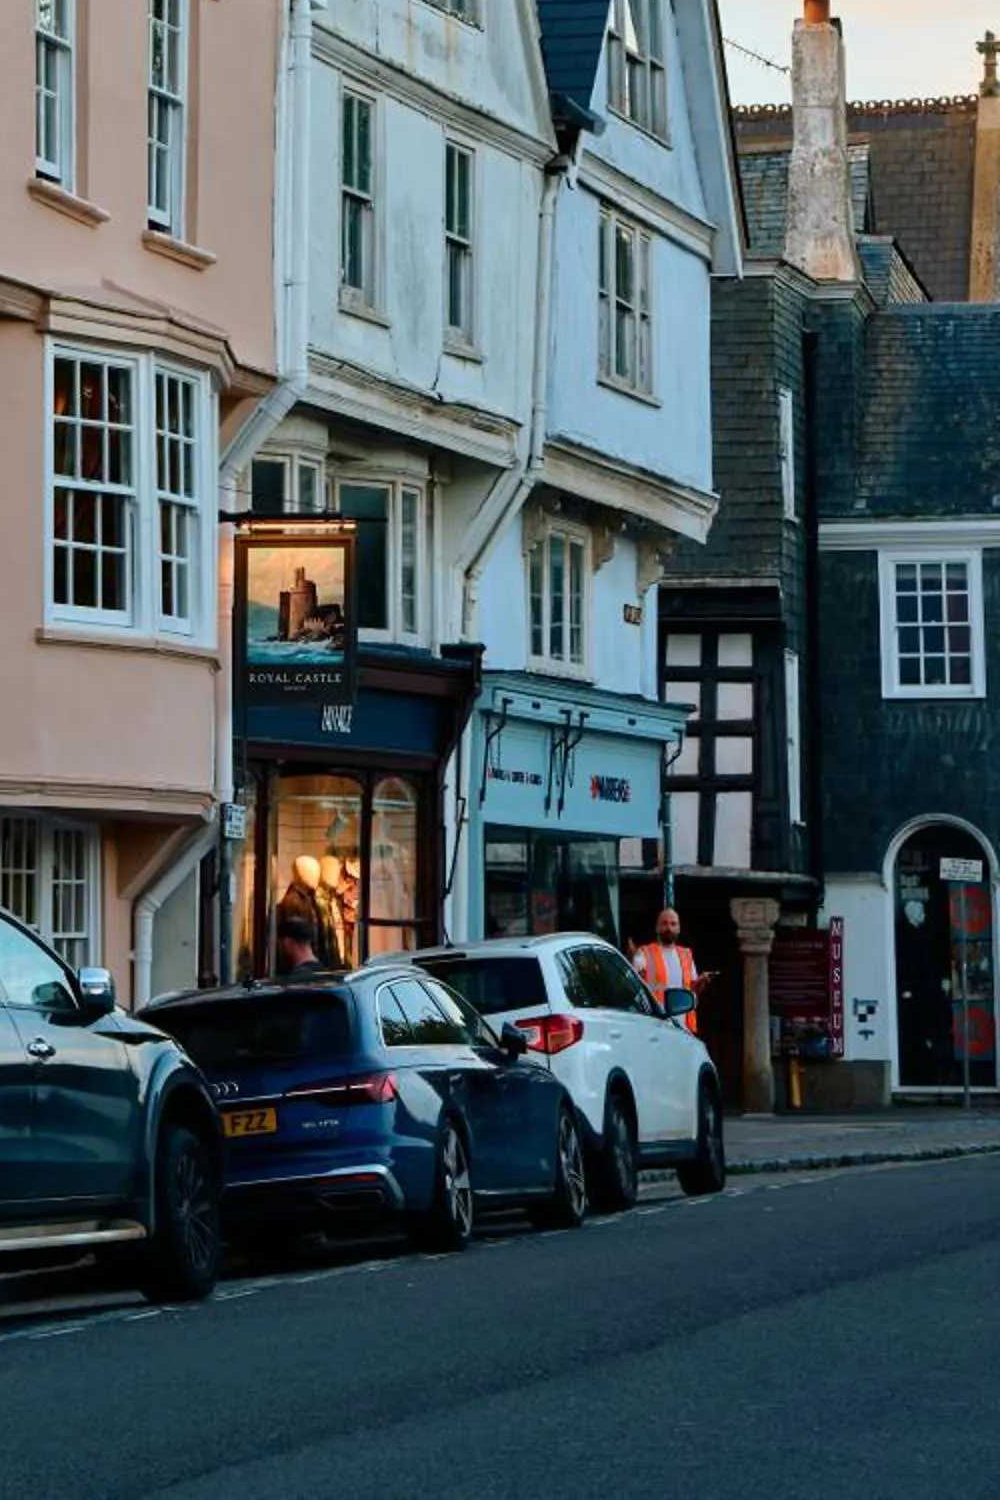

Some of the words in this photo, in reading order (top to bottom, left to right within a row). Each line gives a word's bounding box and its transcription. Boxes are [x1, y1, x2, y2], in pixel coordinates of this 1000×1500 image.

[249, 672, 290, 684] ROYAL
[295, 672, 342, 684] CASTLE
[830, 920, 843, 1053] MUSEUM
